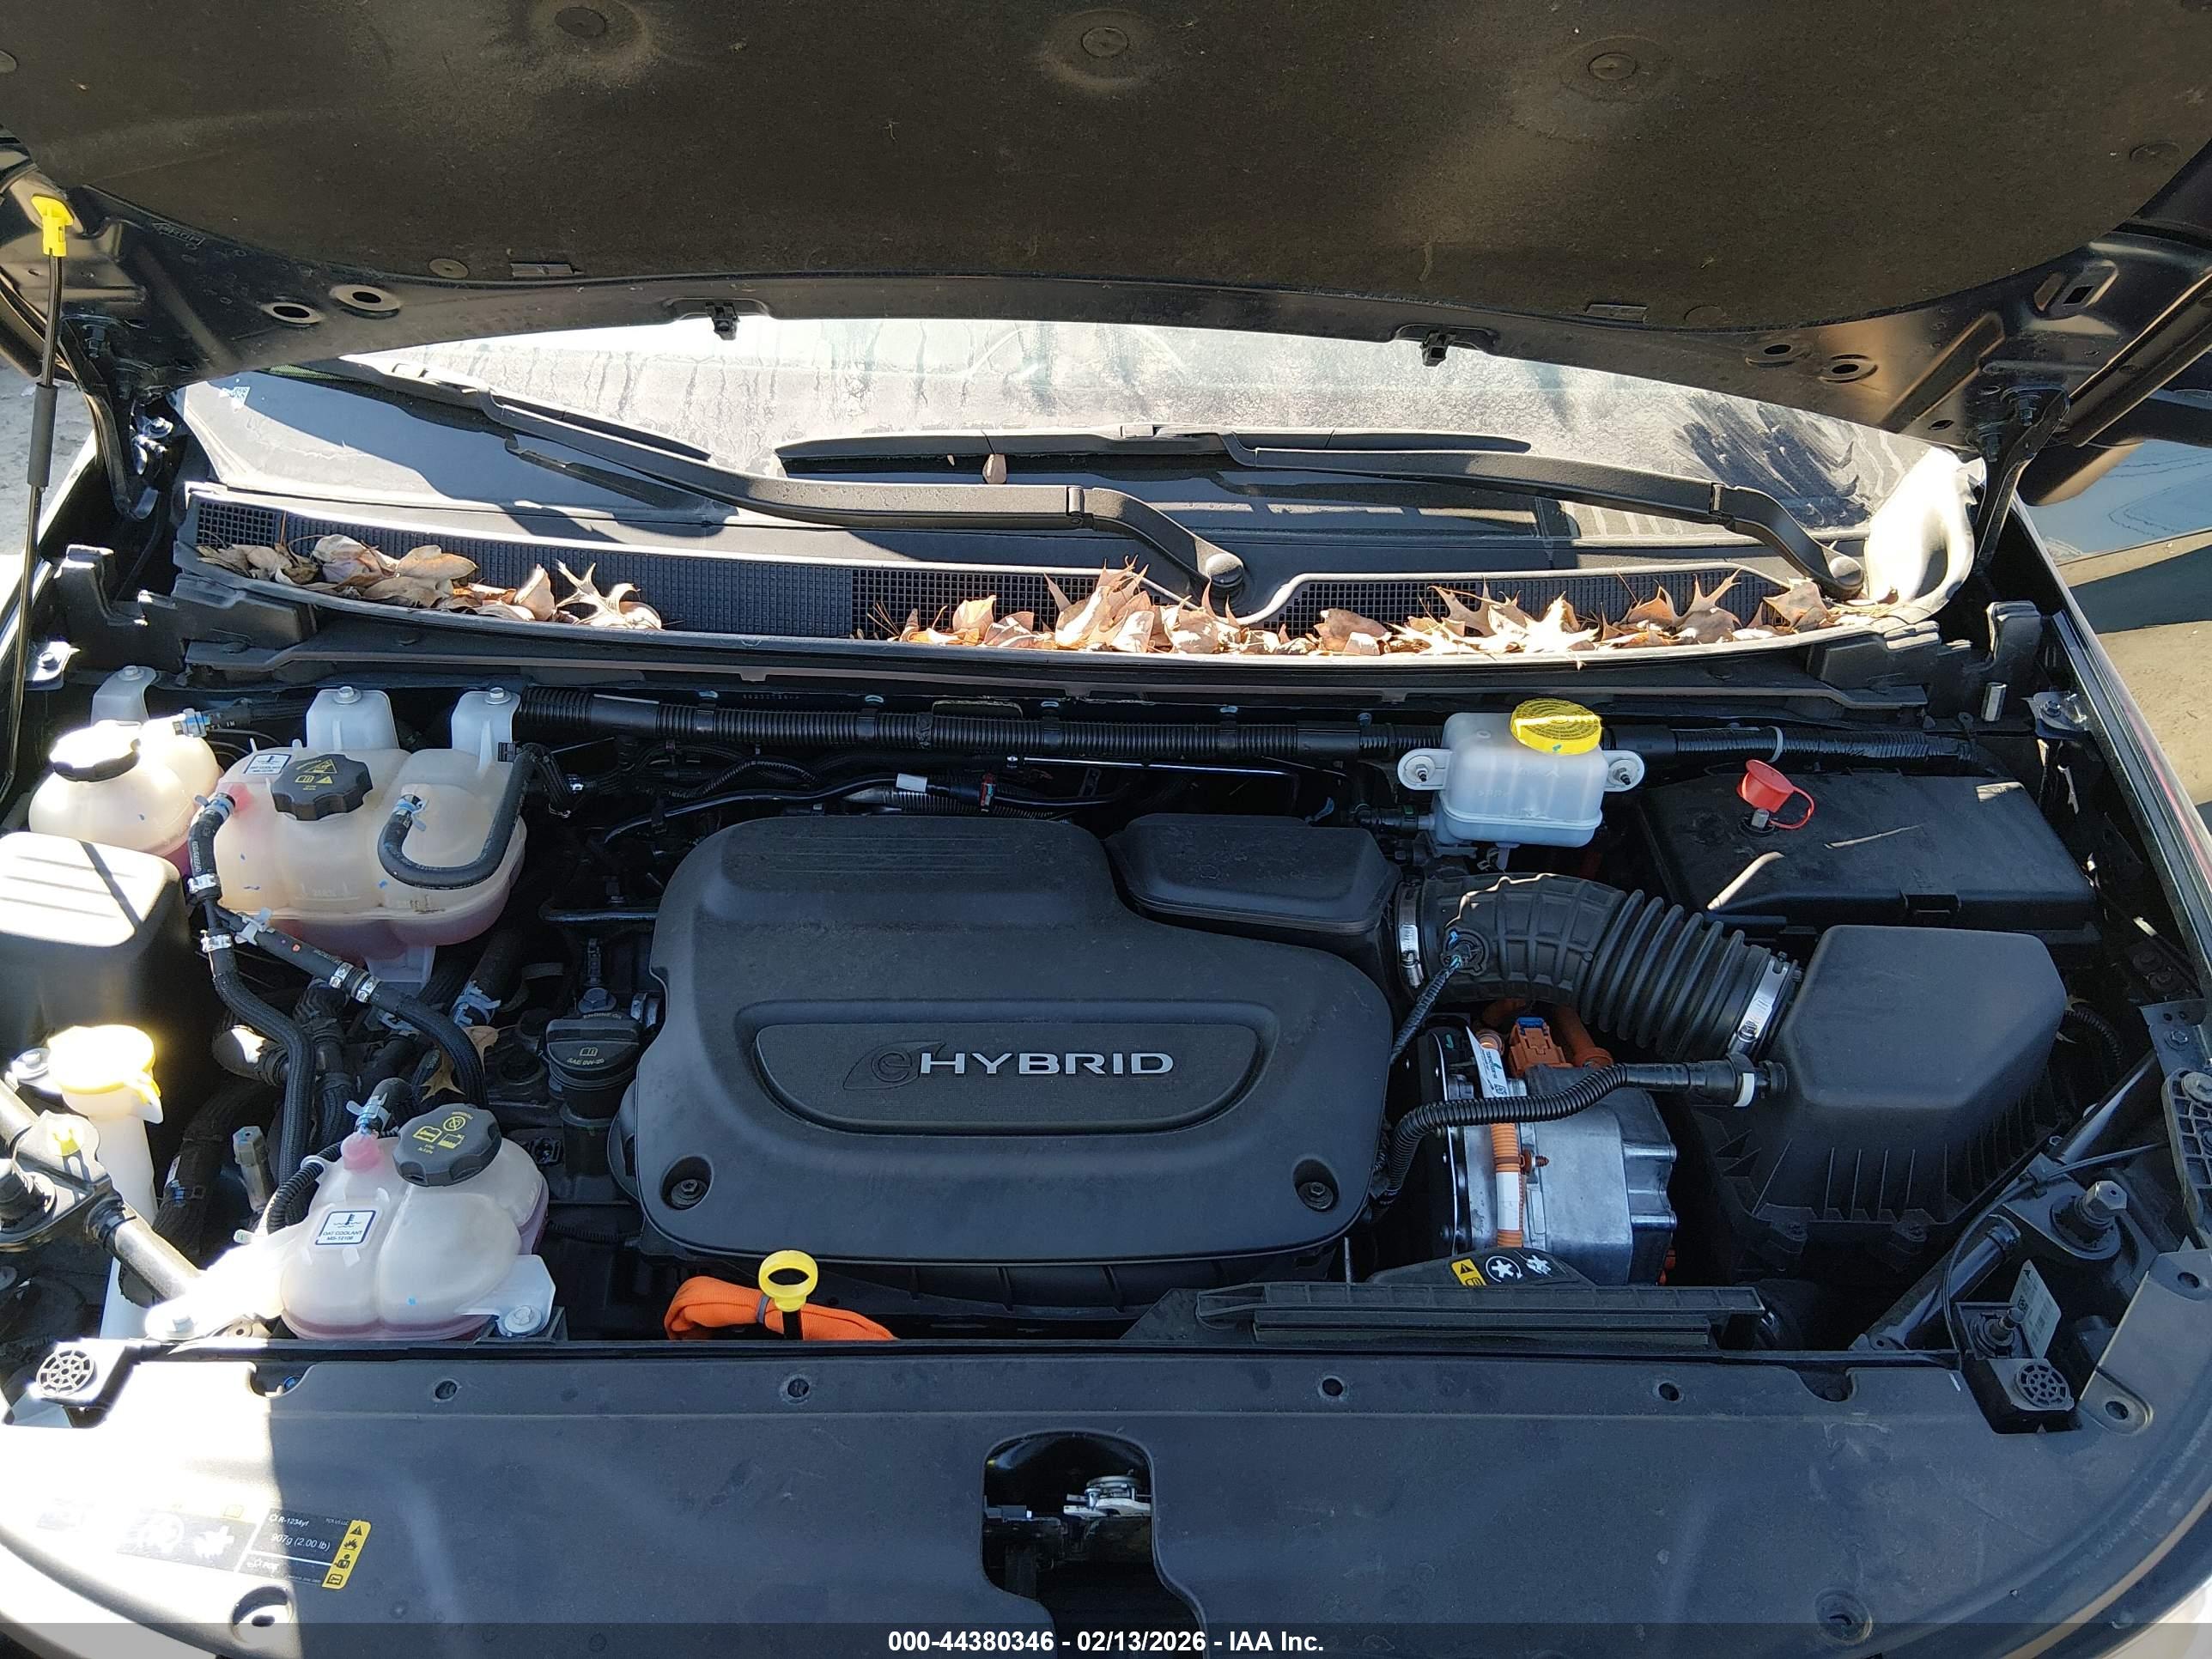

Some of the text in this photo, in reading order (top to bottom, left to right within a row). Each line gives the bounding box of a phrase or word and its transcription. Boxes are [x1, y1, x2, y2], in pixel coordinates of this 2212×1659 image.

[567, 1057, 581, 1066] SAE
[920, 1052, 1175, 1076] HYBRID
[278, 1516, 309, 1527] R-1234yf
[270, 1534, 331, 1552] 907g (2.00 lb)
